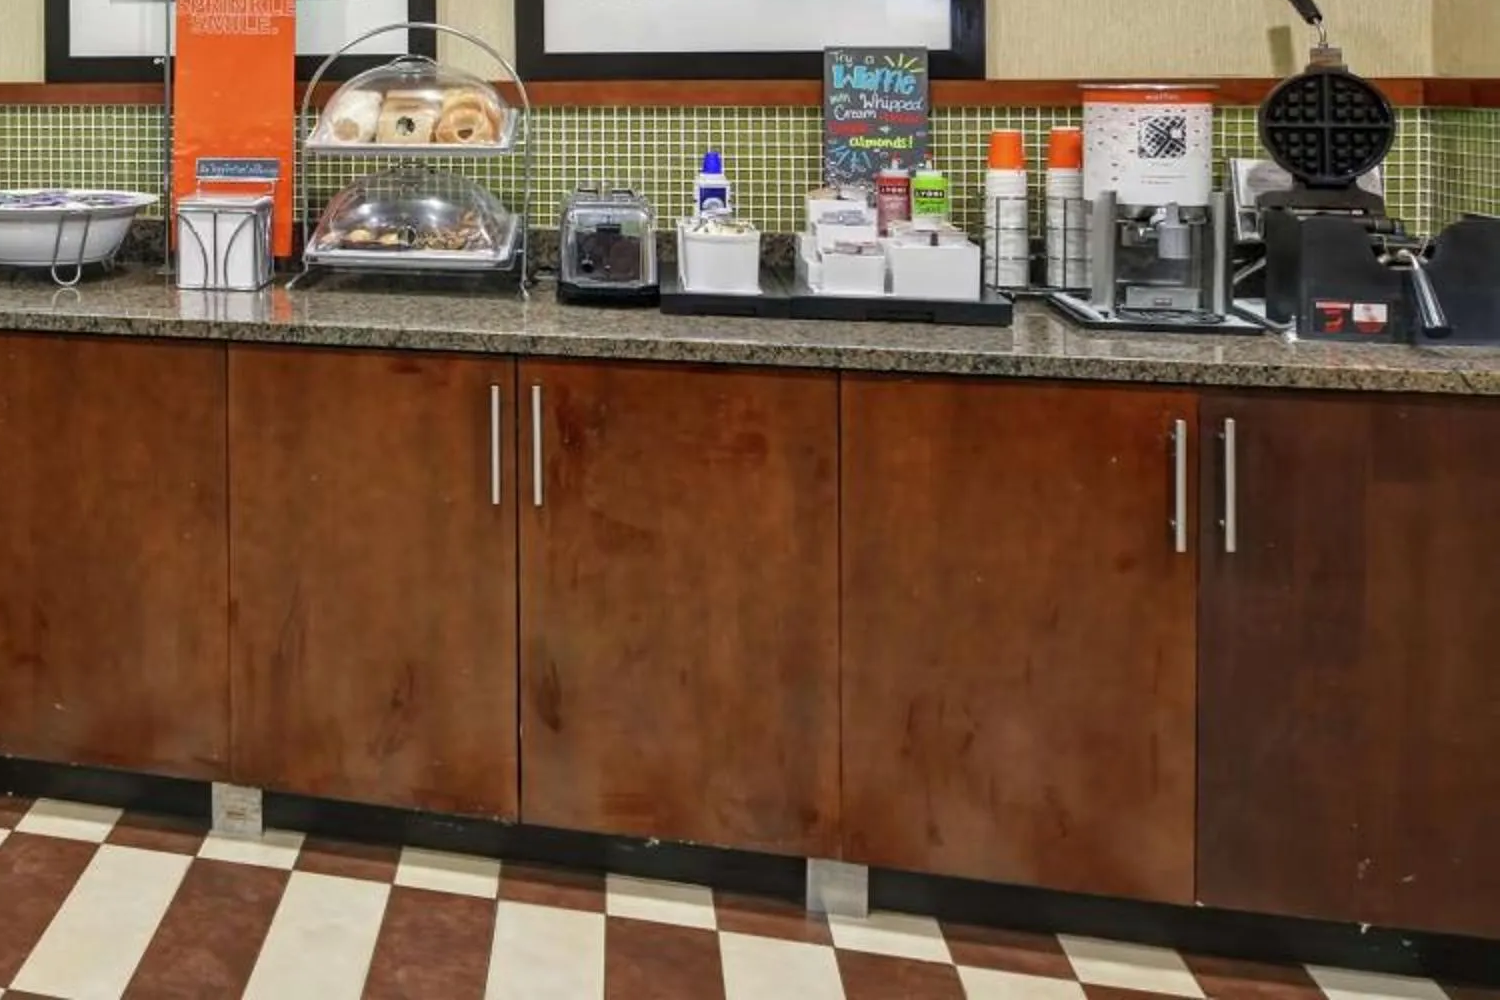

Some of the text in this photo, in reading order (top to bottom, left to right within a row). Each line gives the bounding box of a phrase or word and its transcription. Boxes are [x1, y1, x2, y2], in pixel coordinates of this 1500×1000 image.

[828, 50, 875, 68] Try a
[859, 91, 925, 113] Whipped
